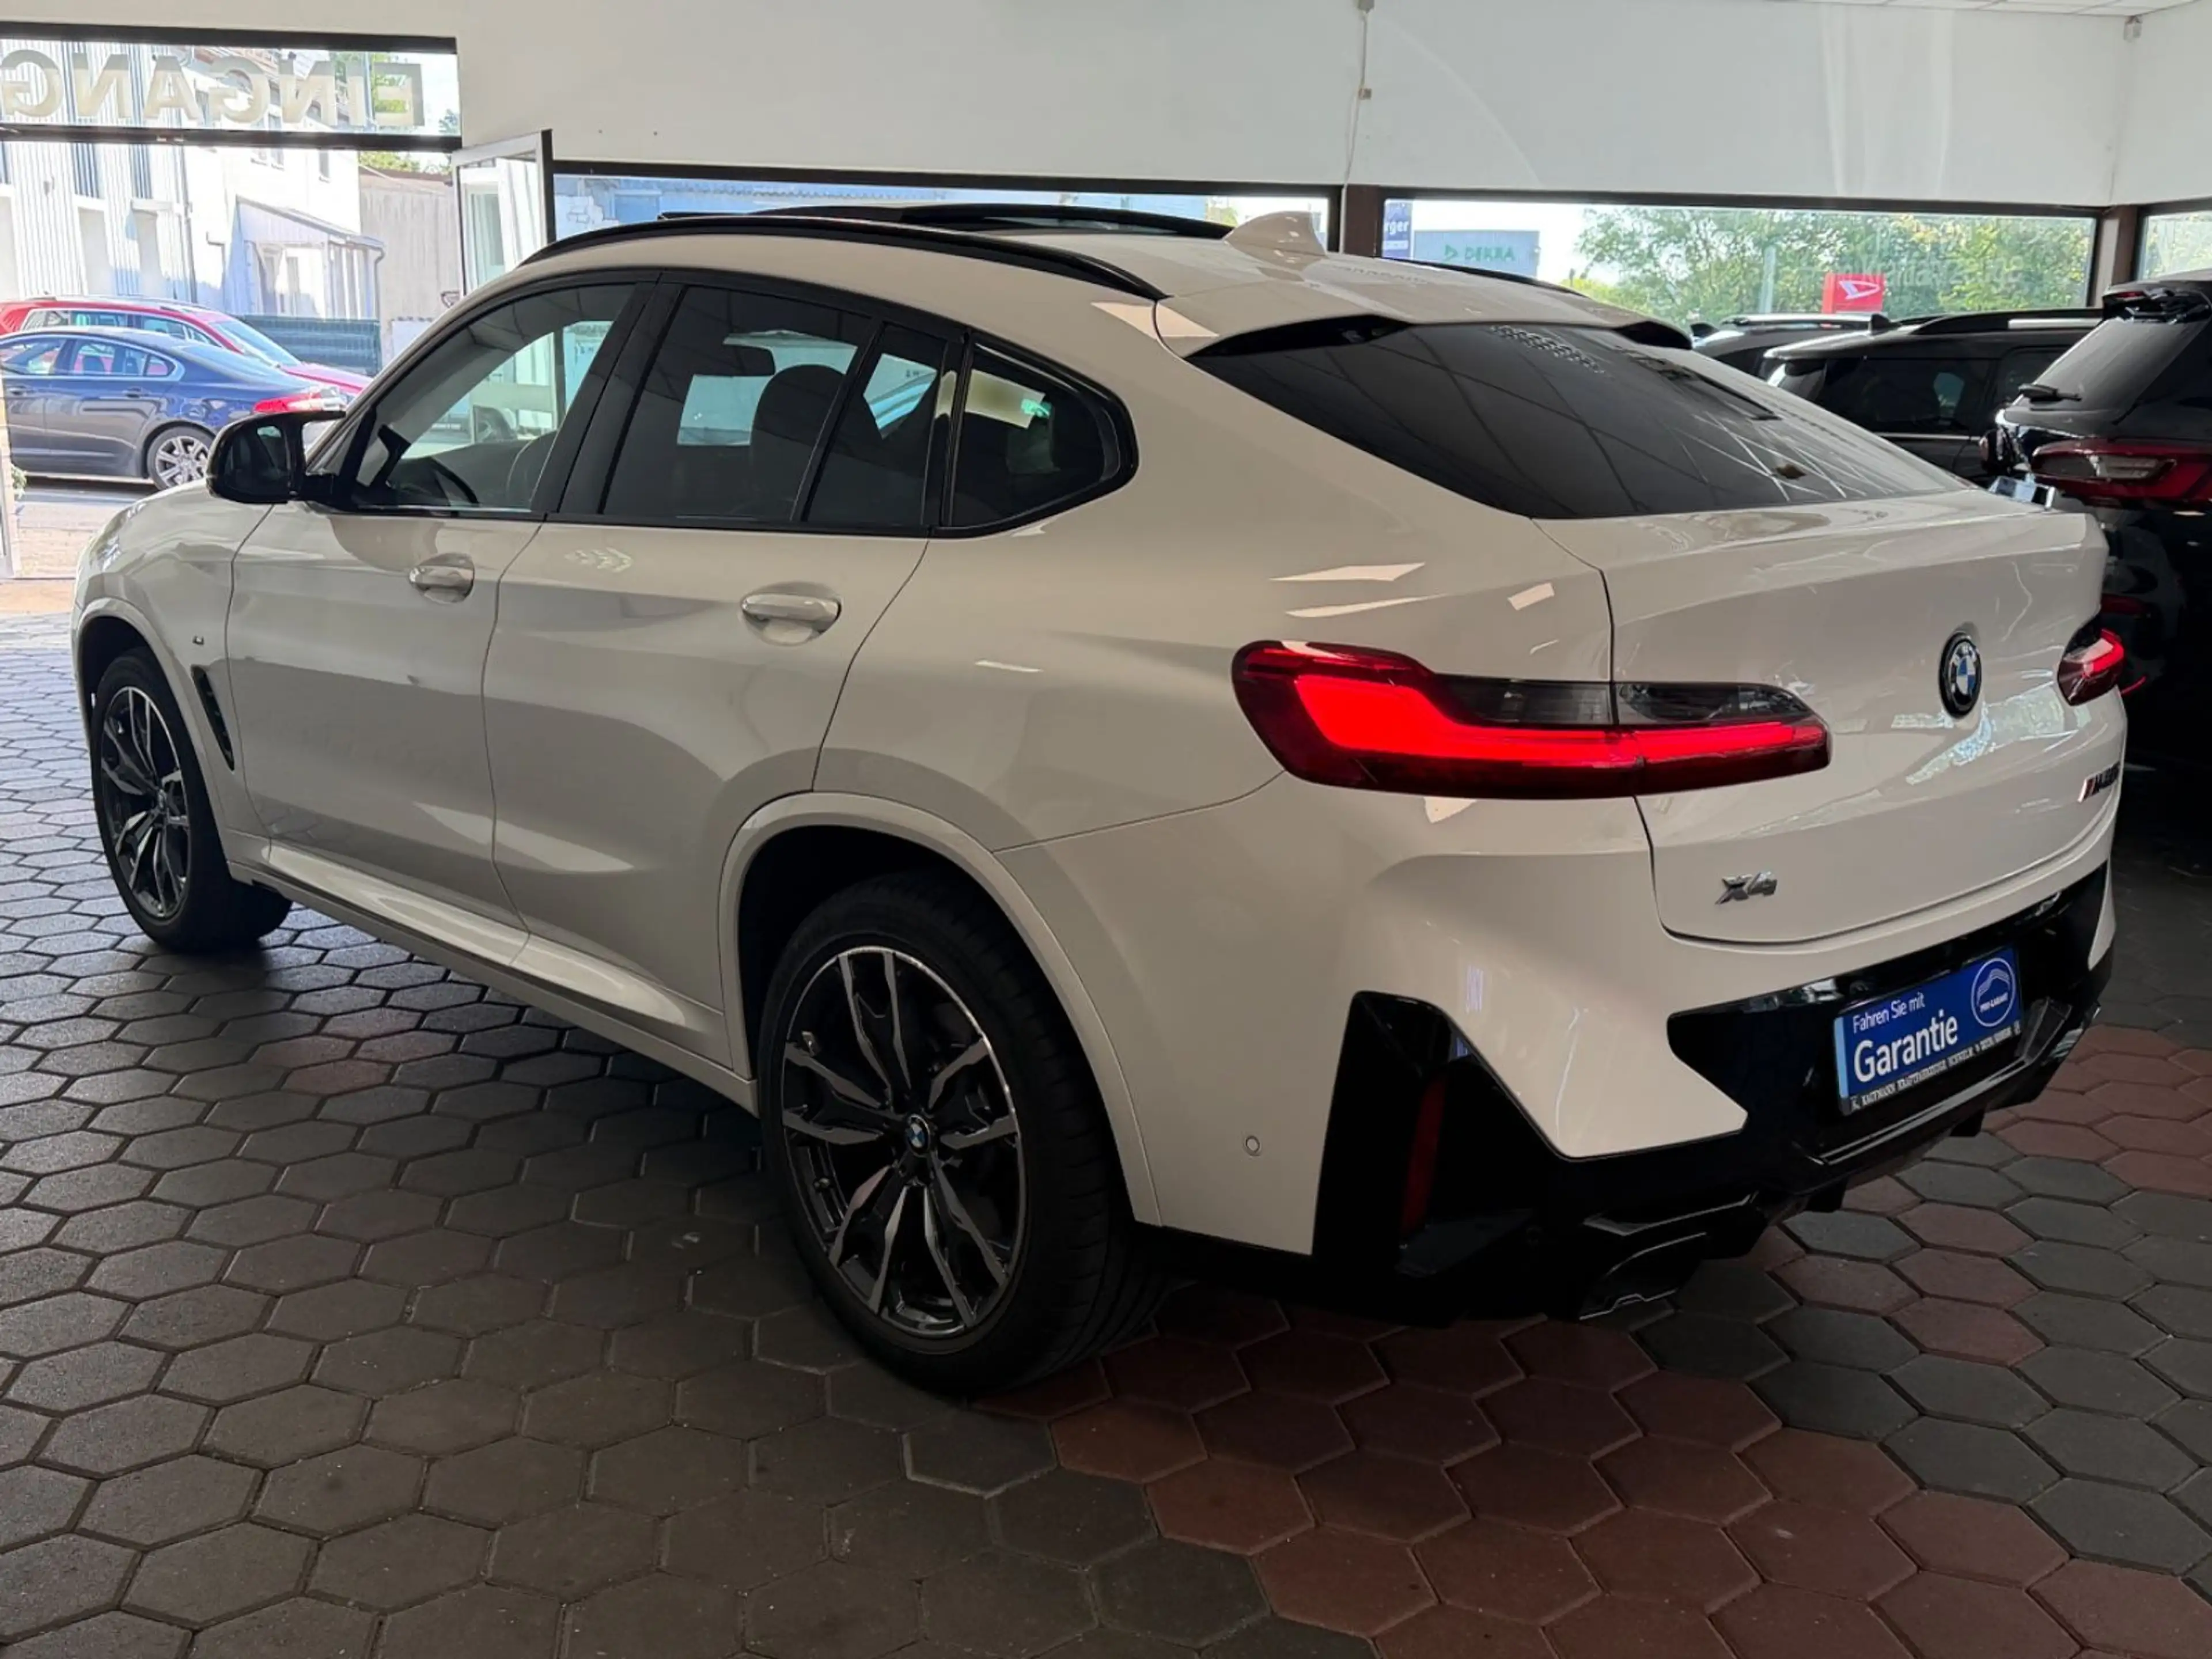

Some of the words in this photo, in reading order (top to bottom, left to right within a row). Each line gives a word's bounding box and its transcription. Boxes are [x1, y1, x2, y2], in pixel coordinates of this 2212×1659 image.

[1714, 872, 1778, 905] X4
[1853, 1009, 1889, 1033] Fahren
[1891, 999, 1907, 1018] Sie
[1909, 991, 1926, 1012] mit
[1854, 1009, 1959, 1082] Garantie
